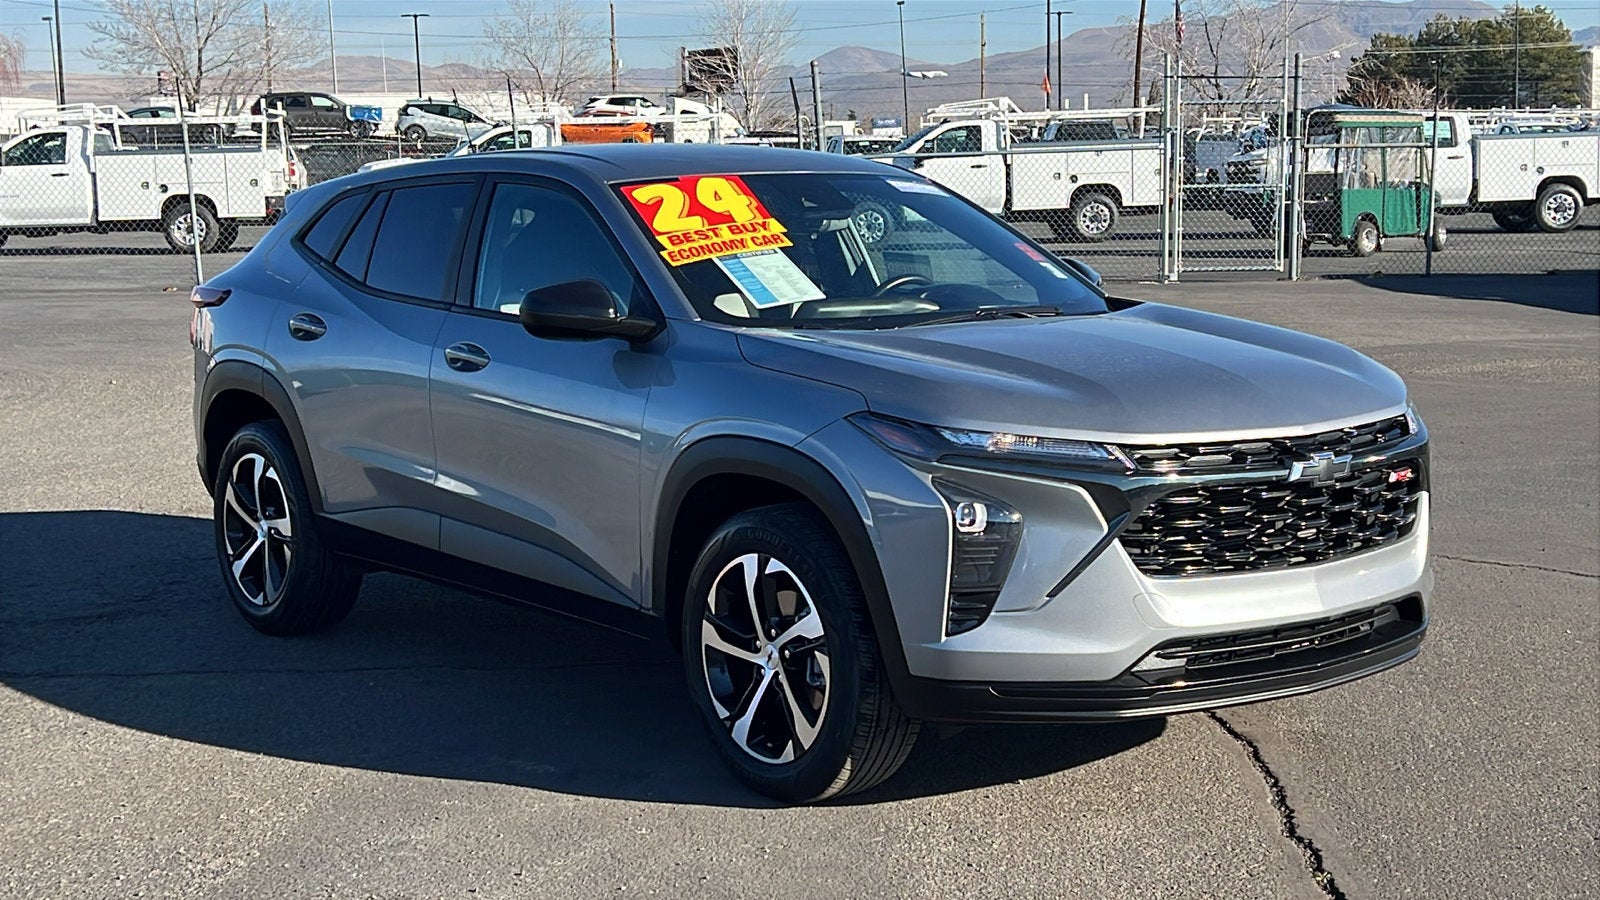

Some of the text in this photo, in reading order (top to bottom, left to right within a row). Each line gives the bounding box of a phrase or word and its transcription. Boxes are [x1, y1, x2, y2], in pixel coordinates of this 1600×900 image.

[632, 177, 761, 232] 24
[668, 233, 785, 262] ECONOMY CAR
[669, 220, 770, 246] BEST BUY
